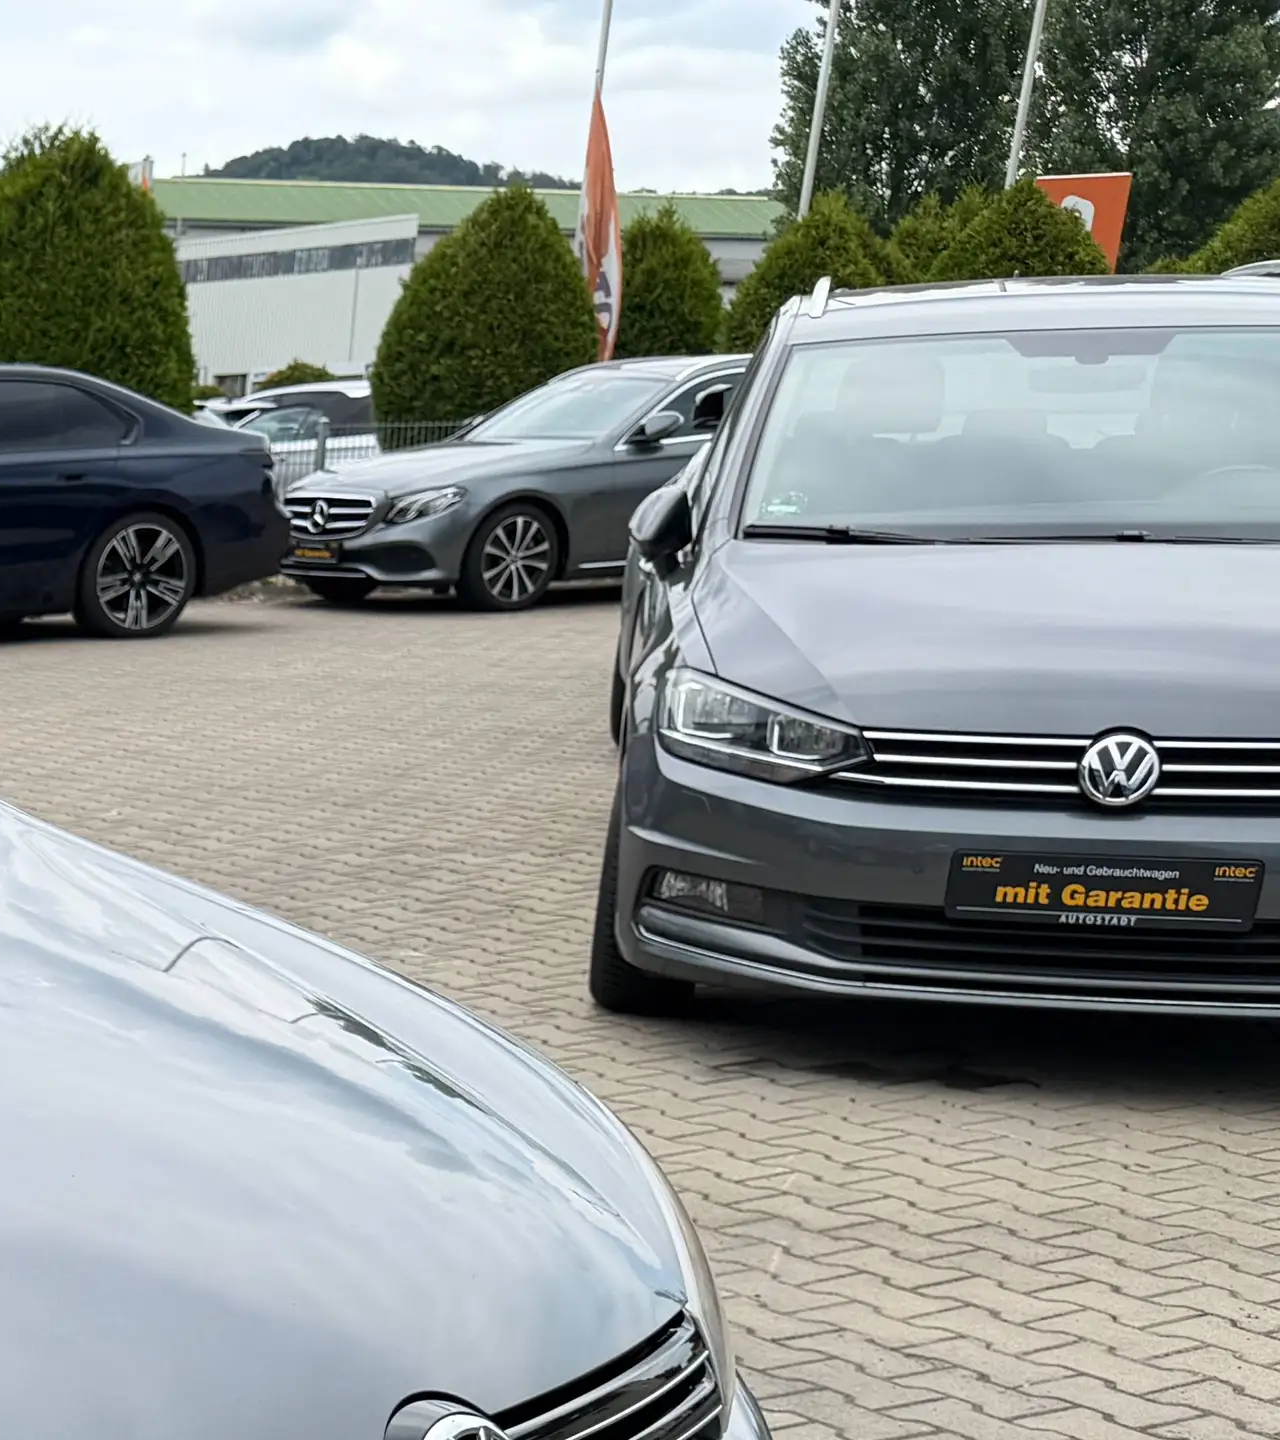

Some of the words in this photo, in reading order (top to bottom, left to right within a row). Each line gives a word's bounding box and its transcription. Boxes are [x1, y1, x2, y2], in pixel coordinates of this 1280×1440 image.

[962, 856, 1001, 868] intec
[1033, 863, 1060, 875] Neu-
[1062, 864, 1085, 876] und
[1086, 865, 1181, 881] Gebrauchtwagen
[1214, 866, 1256, 878] intec
[995, 881, 1051, 905] mit
[1061, 883, 1210, 912] Garantie
[1058, 914, 1138, 927] AUTOSTADT
